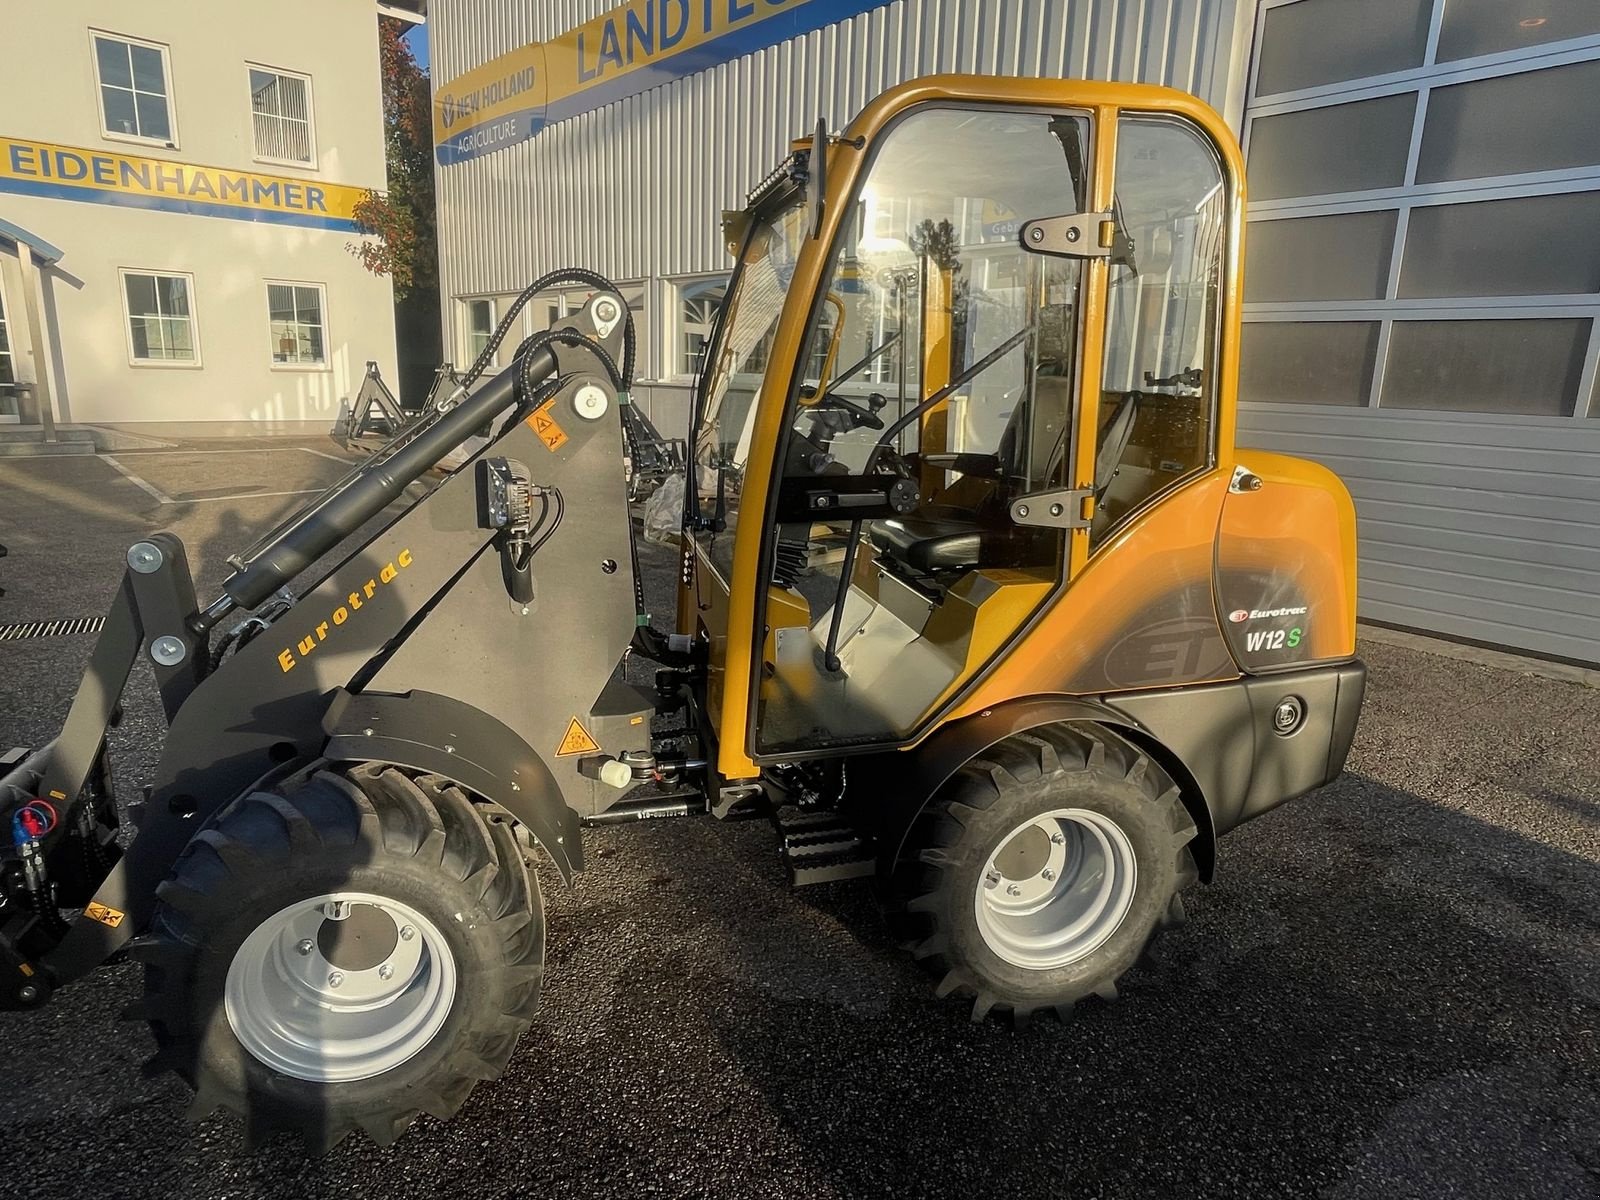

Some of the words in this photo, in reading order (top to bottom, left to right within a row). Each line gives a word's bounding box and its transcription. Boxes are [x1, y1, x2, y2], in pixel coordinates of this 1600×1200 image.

[577, 0, 788, 84] LAND
[456, 90, 480, 119] NEW
[482, 66, 536, 108] HOLLAND
[457, 119, 517, 154] AGRICULTURE
[9, 144, 328, 212] EIDENHAMMER
[277, 548, 414, 674] Eurotrac
[1249, 607, 1308, 619] Eurotrac
[1246, 629, 1286, 652] W12
[1286, 627, 1302, 648] S
